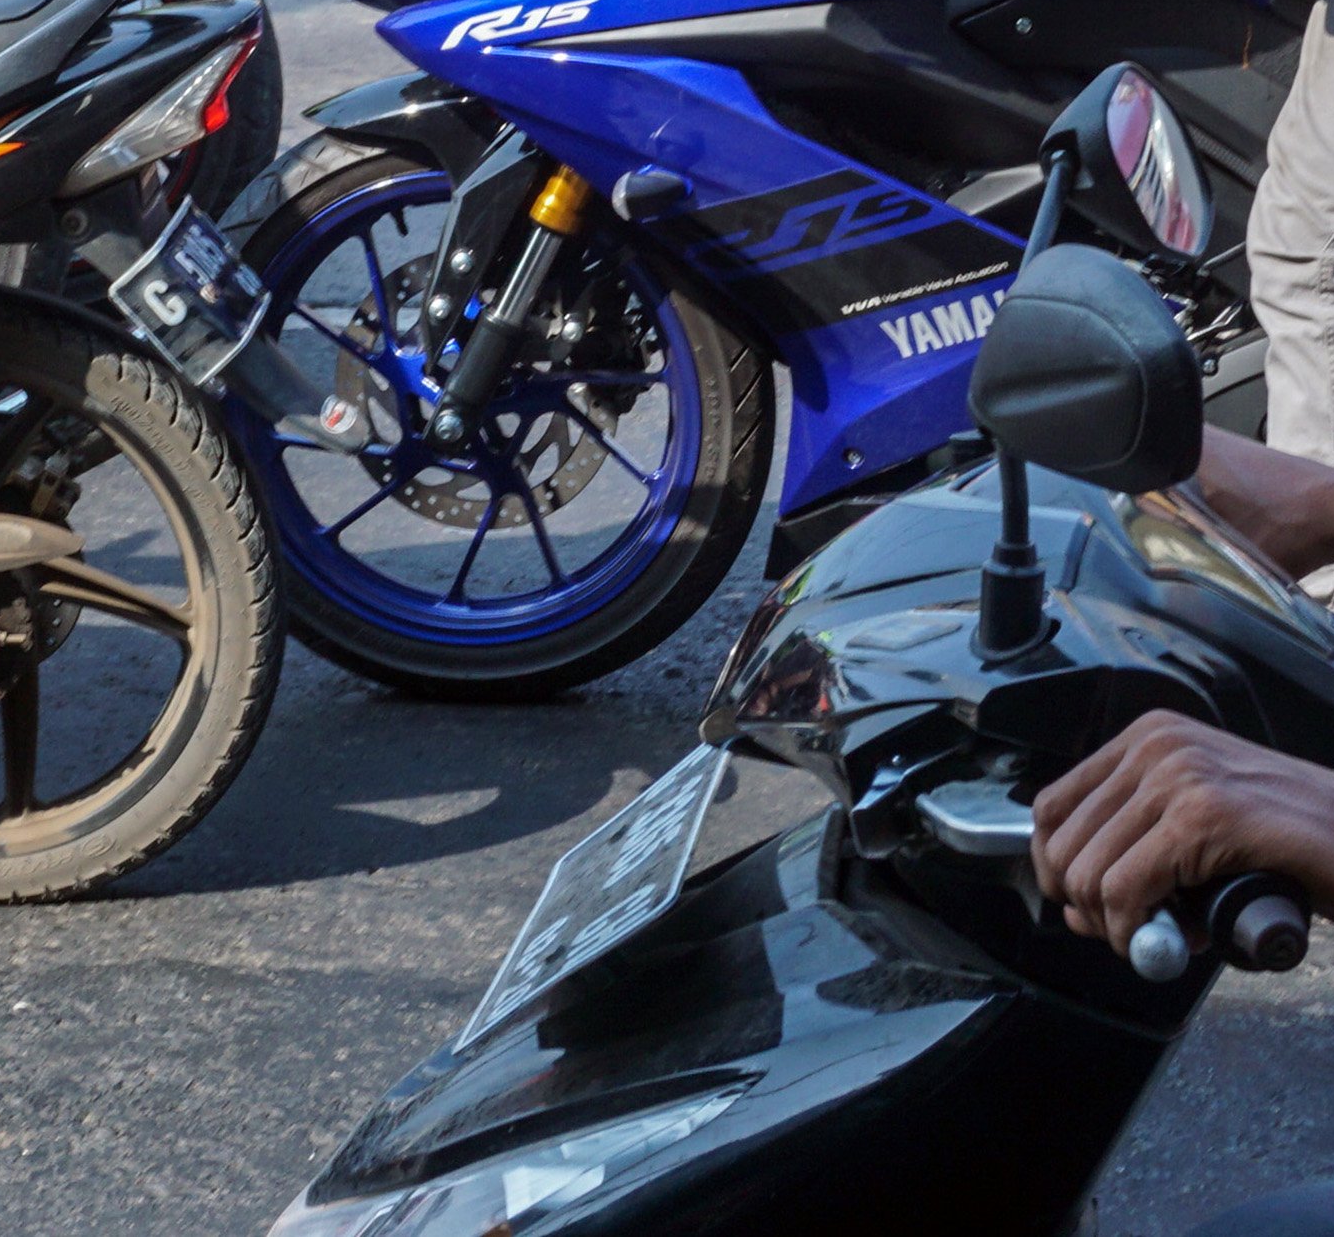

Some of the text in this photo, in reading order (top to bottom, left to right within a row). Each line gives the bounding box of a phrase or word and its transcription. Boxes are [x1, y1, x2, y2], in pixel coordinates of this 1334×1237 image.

[954, 260, 1010, 285] Actuation
[143, 279, 188, 327] G
[879, 289, 1007, 359] YAMA
